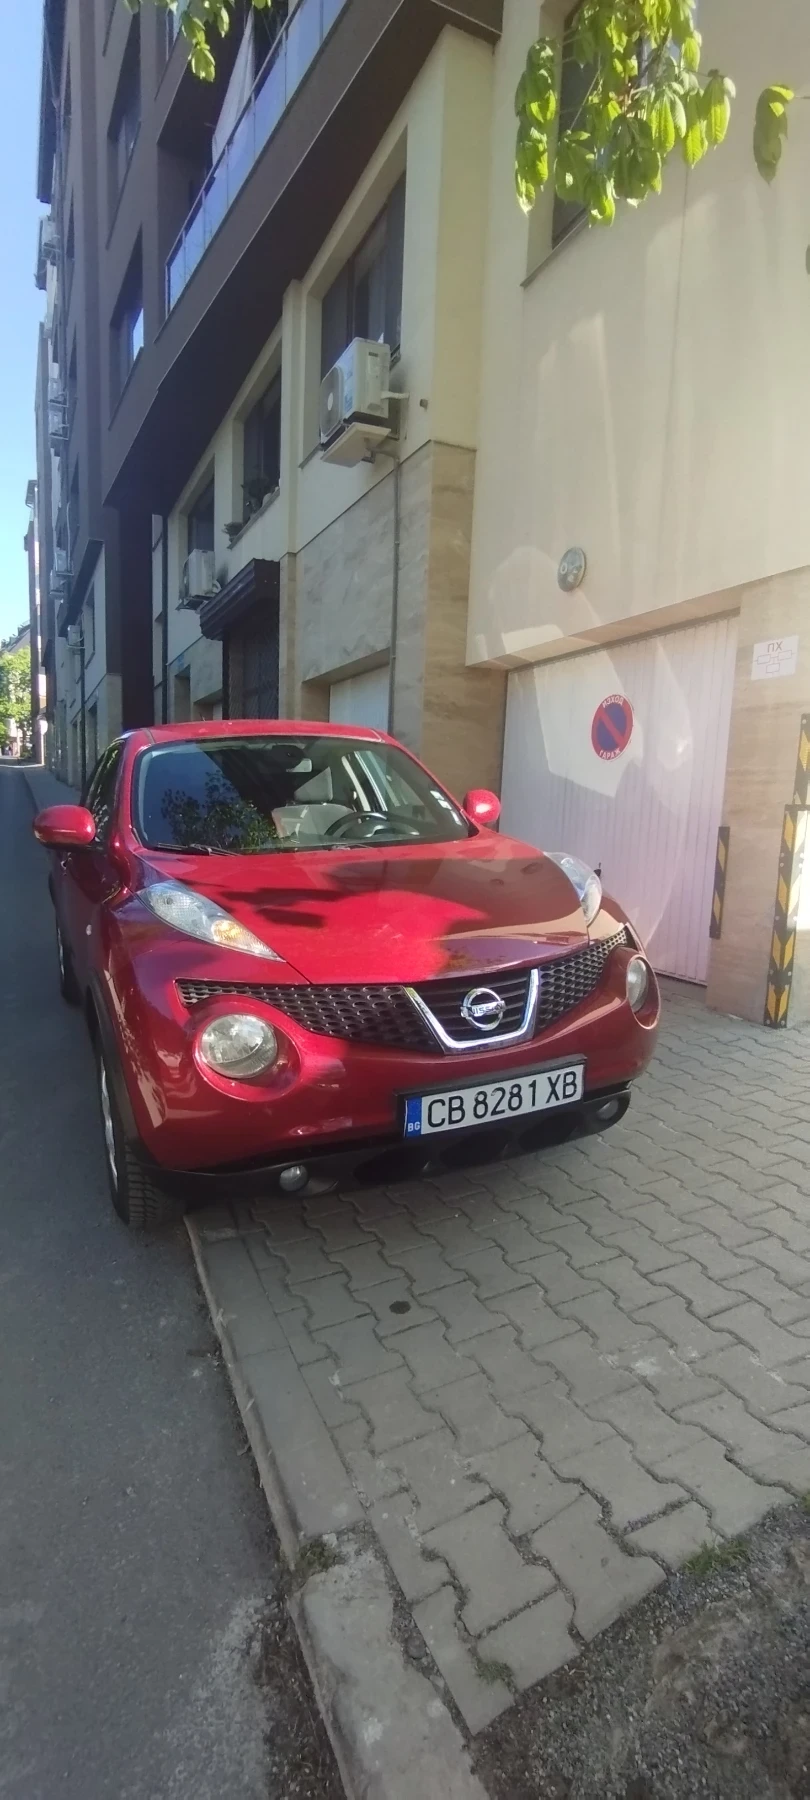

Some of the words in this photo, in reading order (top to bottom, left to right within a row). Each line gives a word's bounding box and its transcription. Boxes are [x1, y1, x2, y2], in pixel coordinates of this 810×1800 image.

[767, 641, 783, 653] ПХ
[602, 695, 624, 708] ИЗХОД
[599, 747, 621, 759] ГАРАЖ
[427, 1095, 466, 1128] CB
[473, 1079, 537, 1119] 8281
[545, 1070, 578, 1104] XB
[407, 1121, 421, 1132] BG
